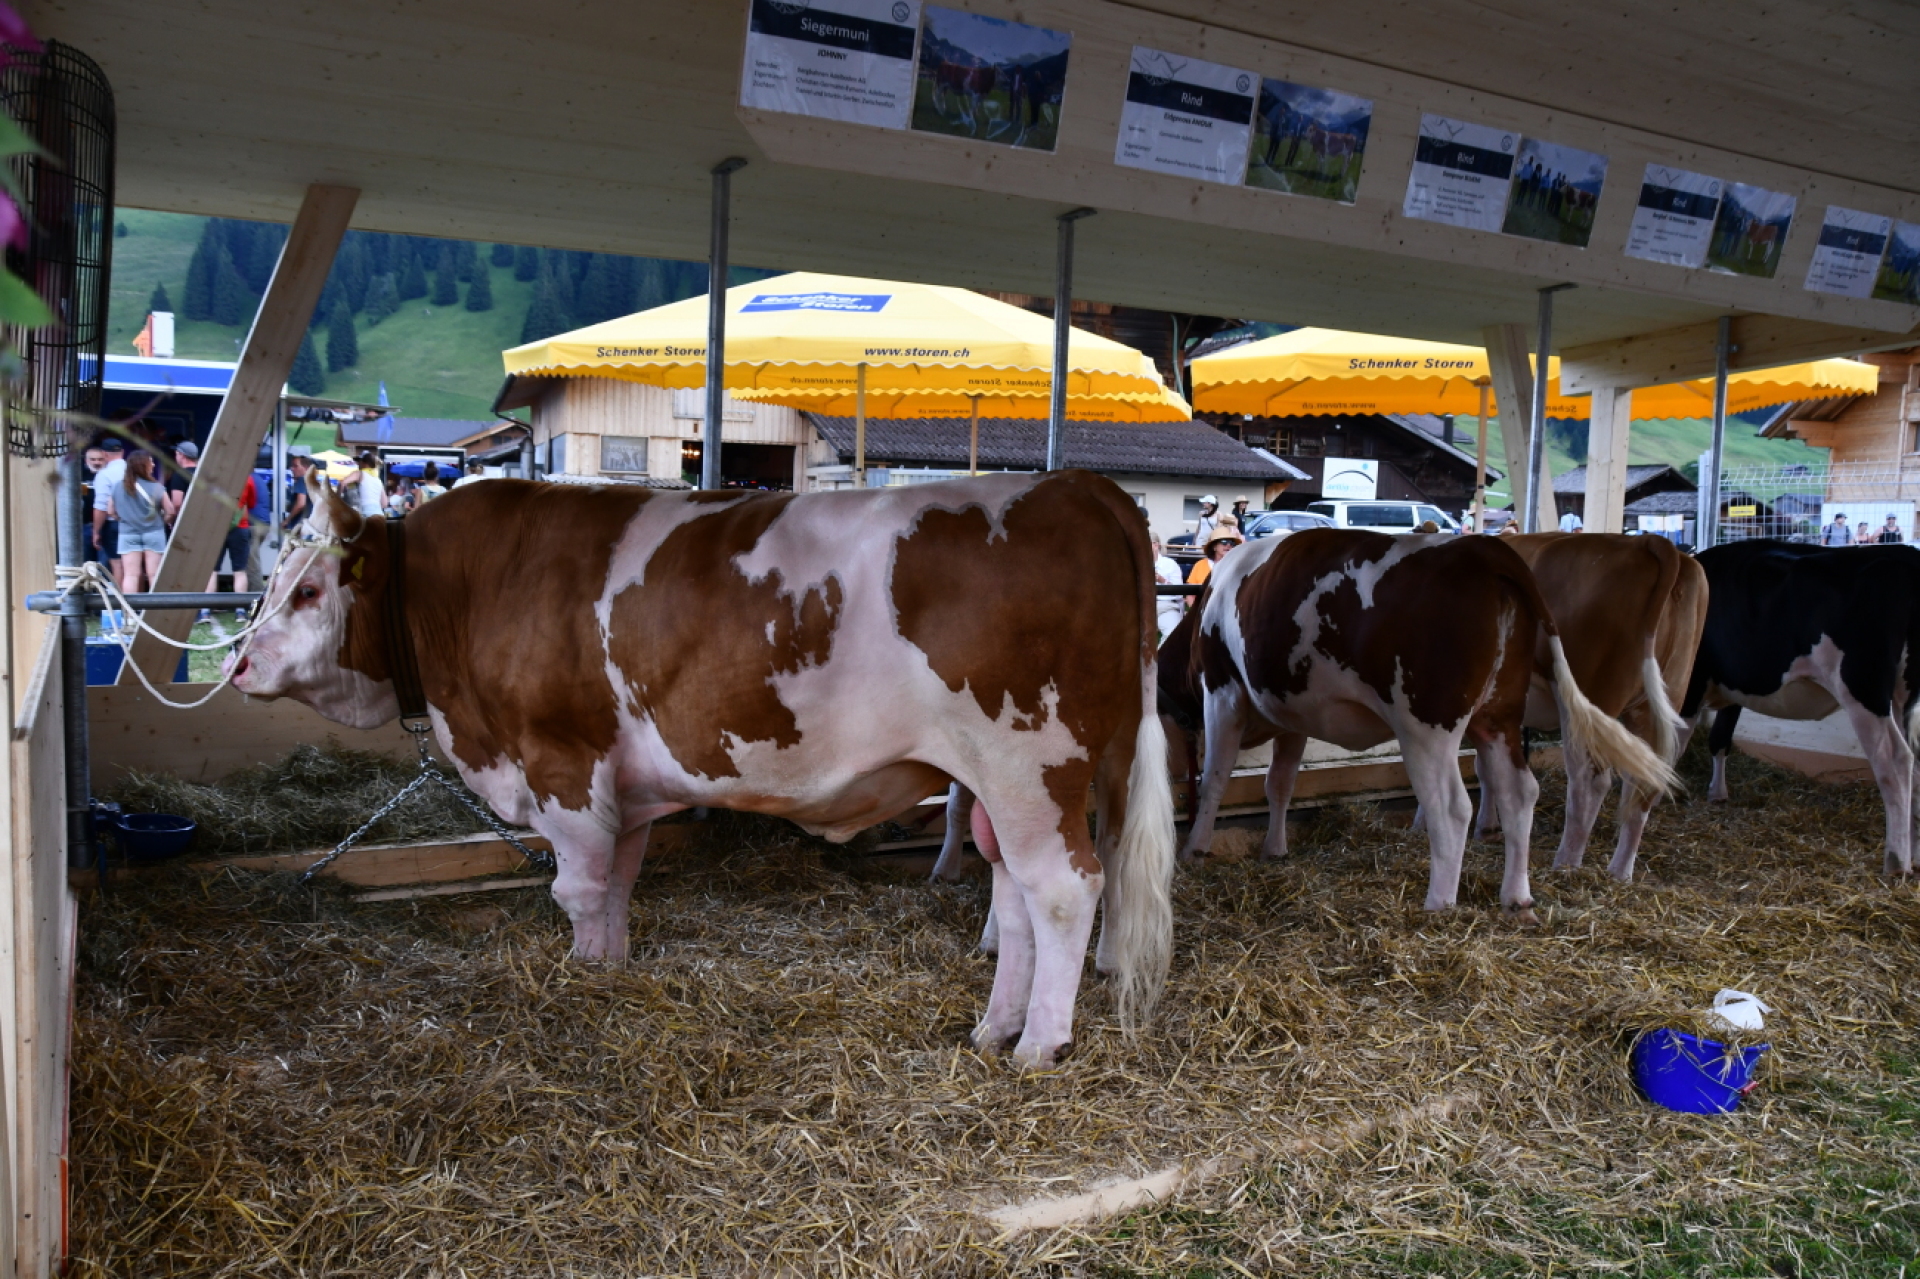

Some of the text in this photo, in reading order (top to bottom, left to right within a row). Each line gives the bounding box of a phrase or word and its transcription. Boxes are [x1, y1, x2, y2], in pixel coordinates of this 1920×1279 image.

[800, 17, 870, 42] Siegermuni
[817, 49, 849, 61] JOHNNY
[1181, 92, 1203, 107] Rind
[596, 346, 659, 358] Schenker
[864, 347, 970, 359] www.storen.ch
[1349, 358, 1475, 370] Schenker Storen
